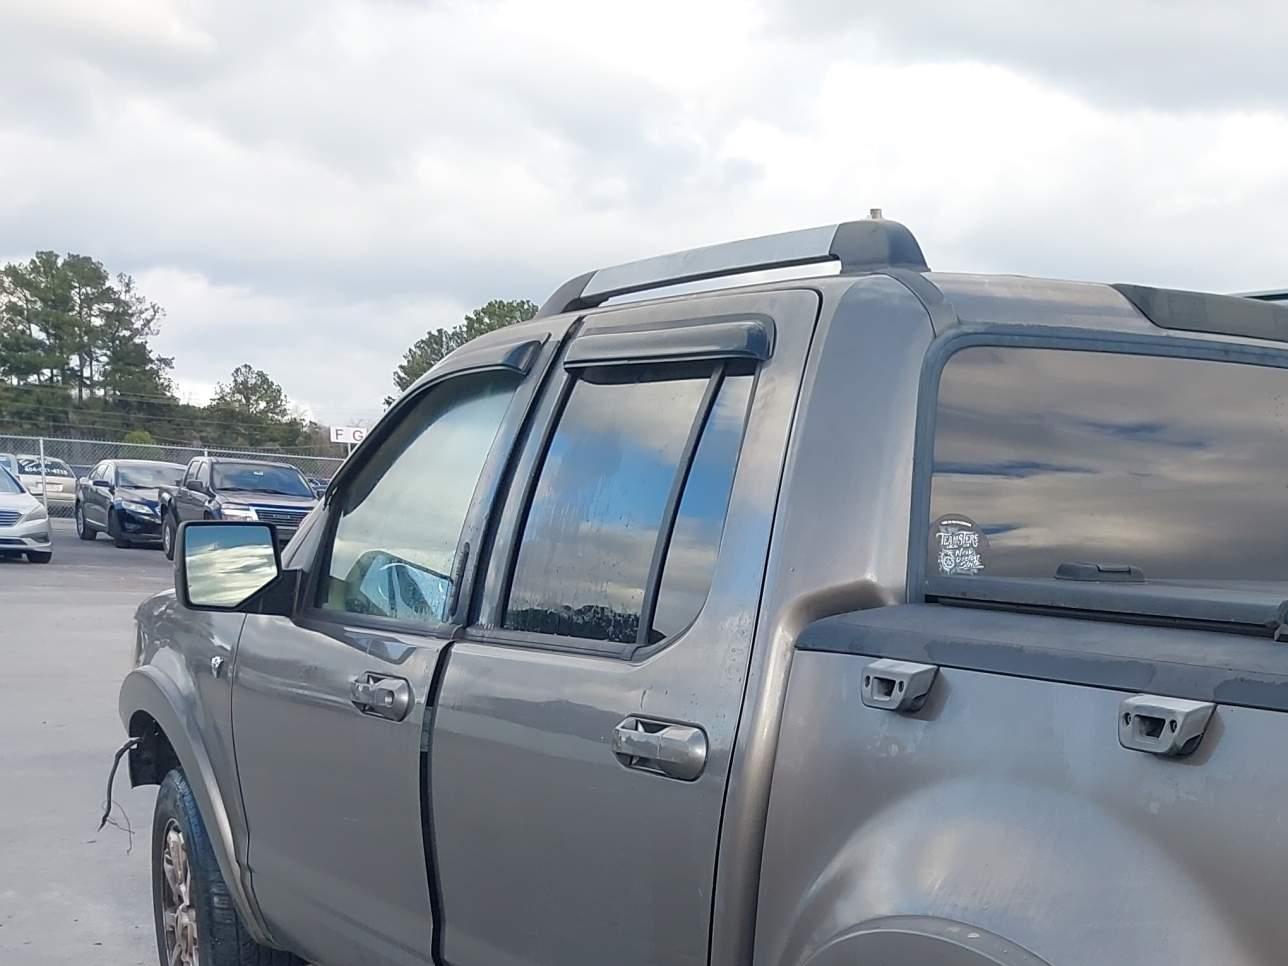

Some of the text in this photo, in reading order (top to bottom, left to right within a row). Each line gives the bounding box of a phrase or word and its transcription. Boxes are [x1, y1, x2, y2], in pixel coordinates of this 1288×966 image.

[335, 428, 364, 442] F G
[935, 531, 979, 547] TEAMSTERS
